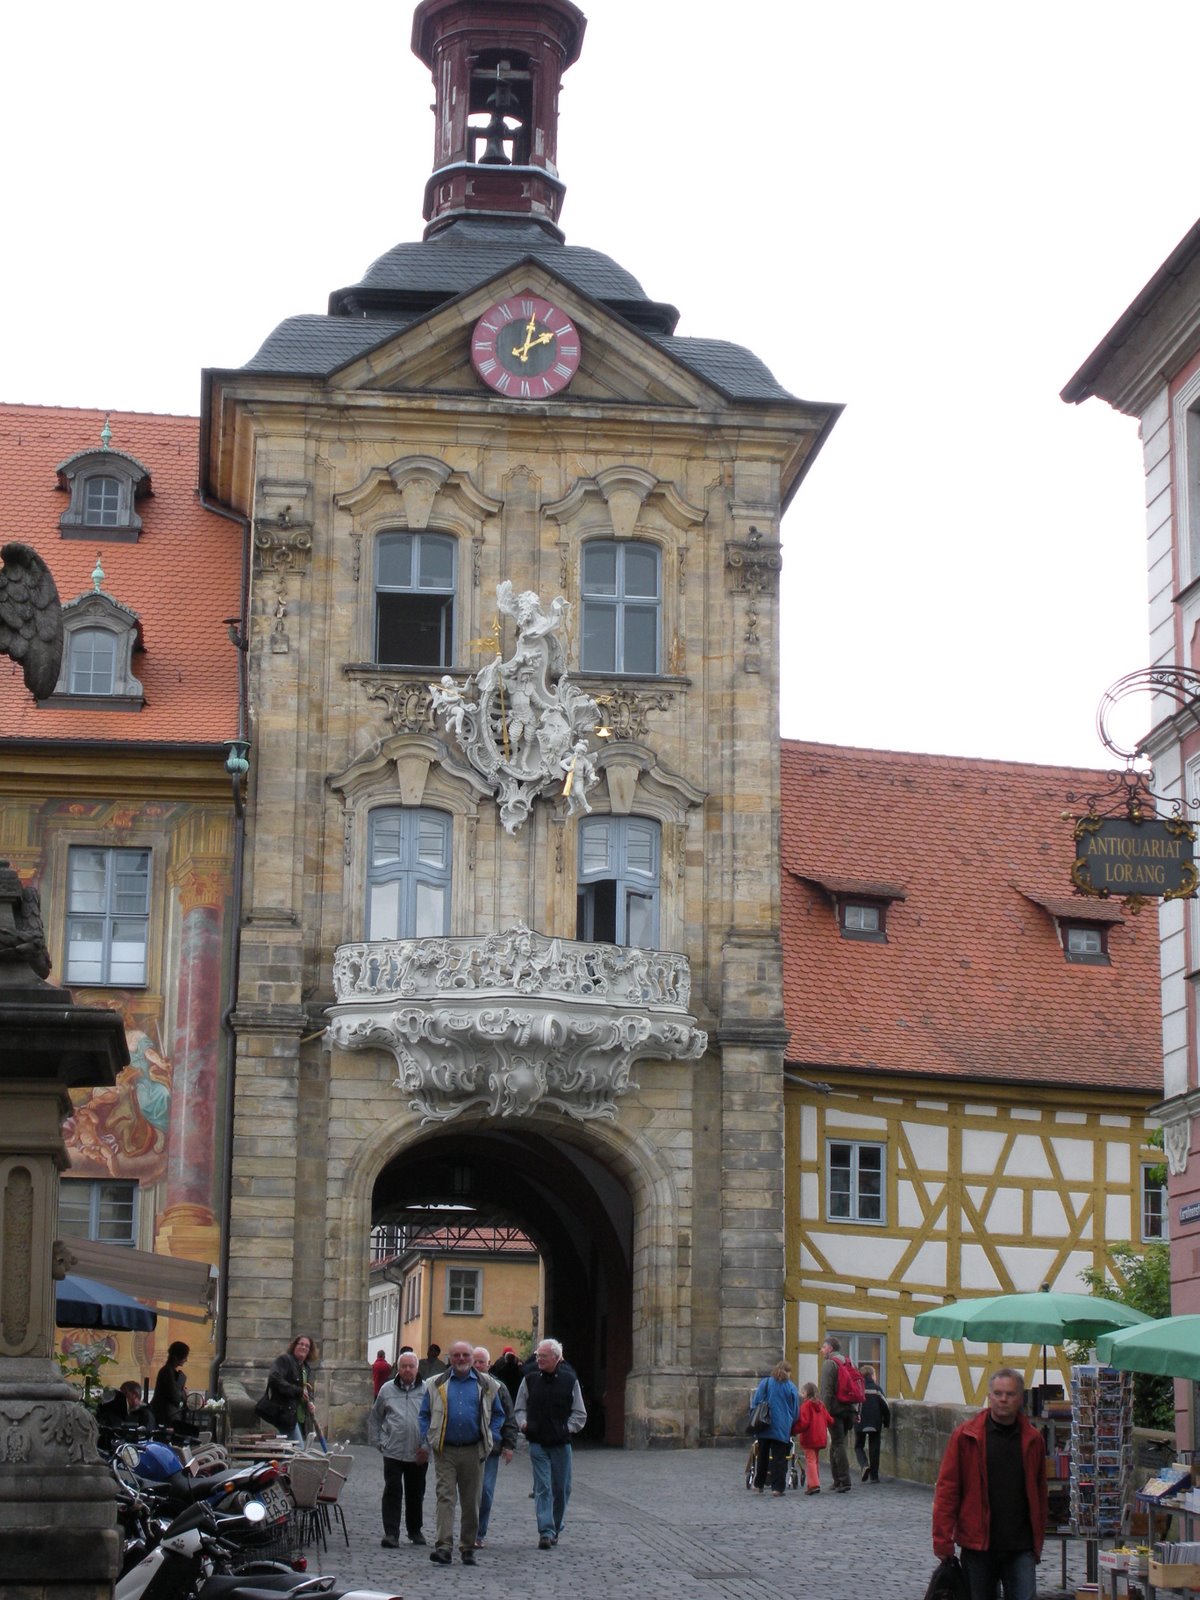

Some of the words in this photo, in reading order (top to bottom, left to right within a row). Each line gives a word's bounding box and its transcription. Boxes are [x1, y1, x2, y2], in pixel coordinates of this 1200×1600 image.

[555, 323, 572, 336] II
[560, 346, 577, 355] III
[553, 362, 572, 379] IIII
[542, 376, 554, 393] V
[1088, 837, 1182, 860] ANTIQUARIAT
[1105, 863, 1165, 884] LORANG
[263, 1489, 279, 1504] BA
